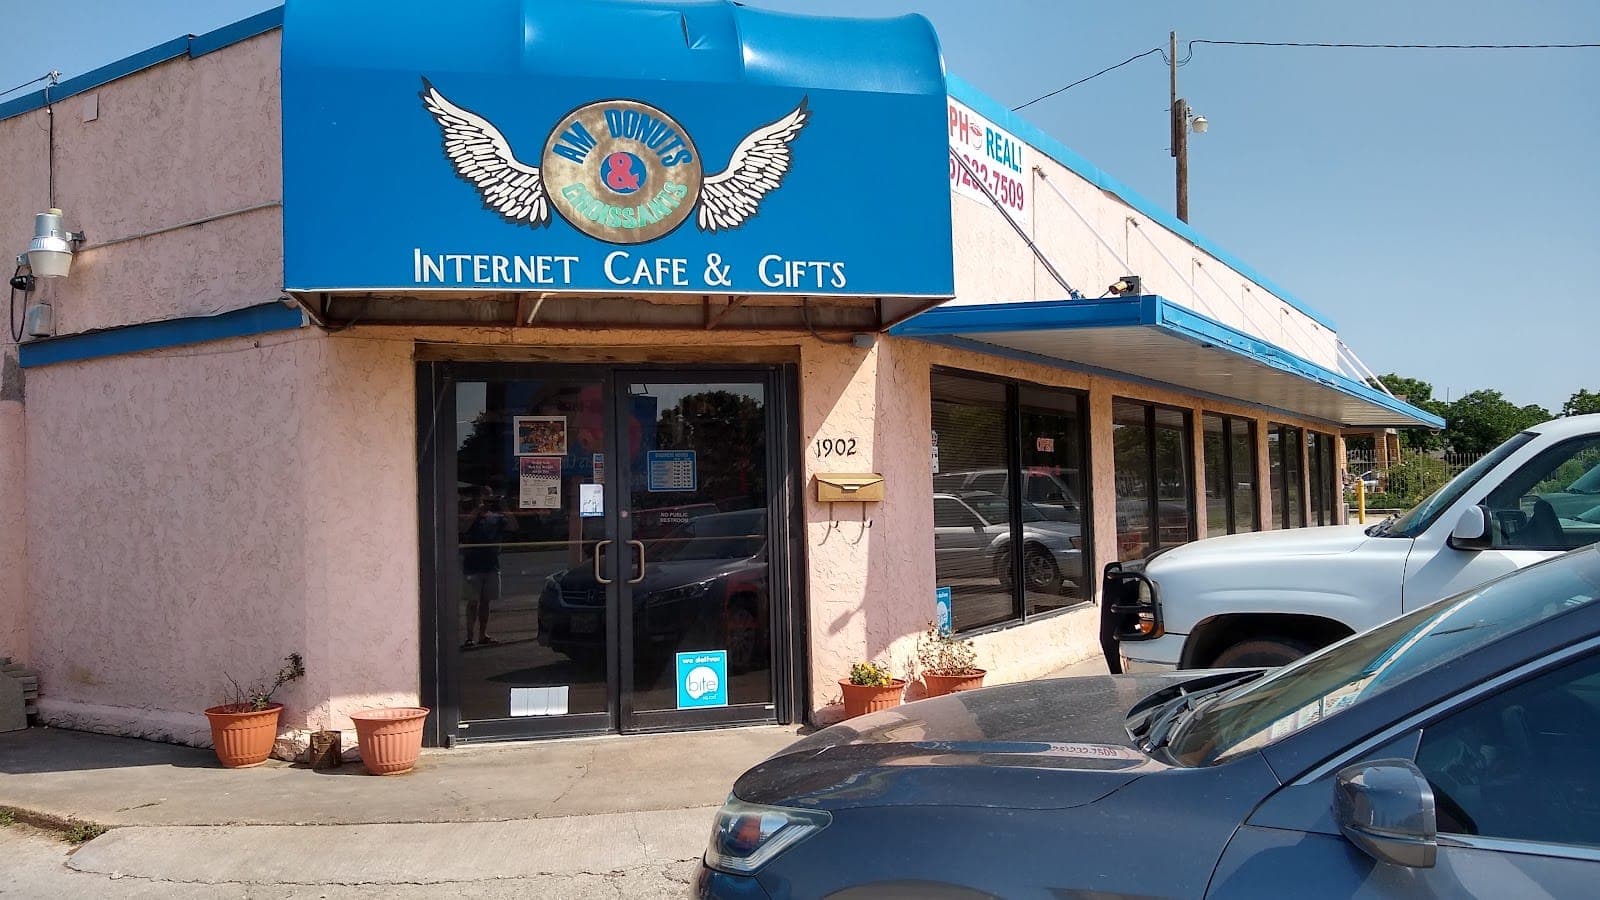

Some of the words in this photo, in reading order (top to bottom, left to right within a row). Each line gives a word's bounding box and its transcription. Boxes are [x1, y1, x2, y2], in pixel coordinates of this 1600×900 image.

[552, 119, 598, 165] AM
[603, 109, 693, 168] DONUTS
[985, 126, 1022, 174] REAL!
[607, 152, 640, 190] &
[561, 182, 688, 229] CROISSANTS
[703, 252, 732, 287] &
[816, 438, 857, 458] 1902
[695, 655, 721, 664] deliver
[688, 675, 716, 692] bite
